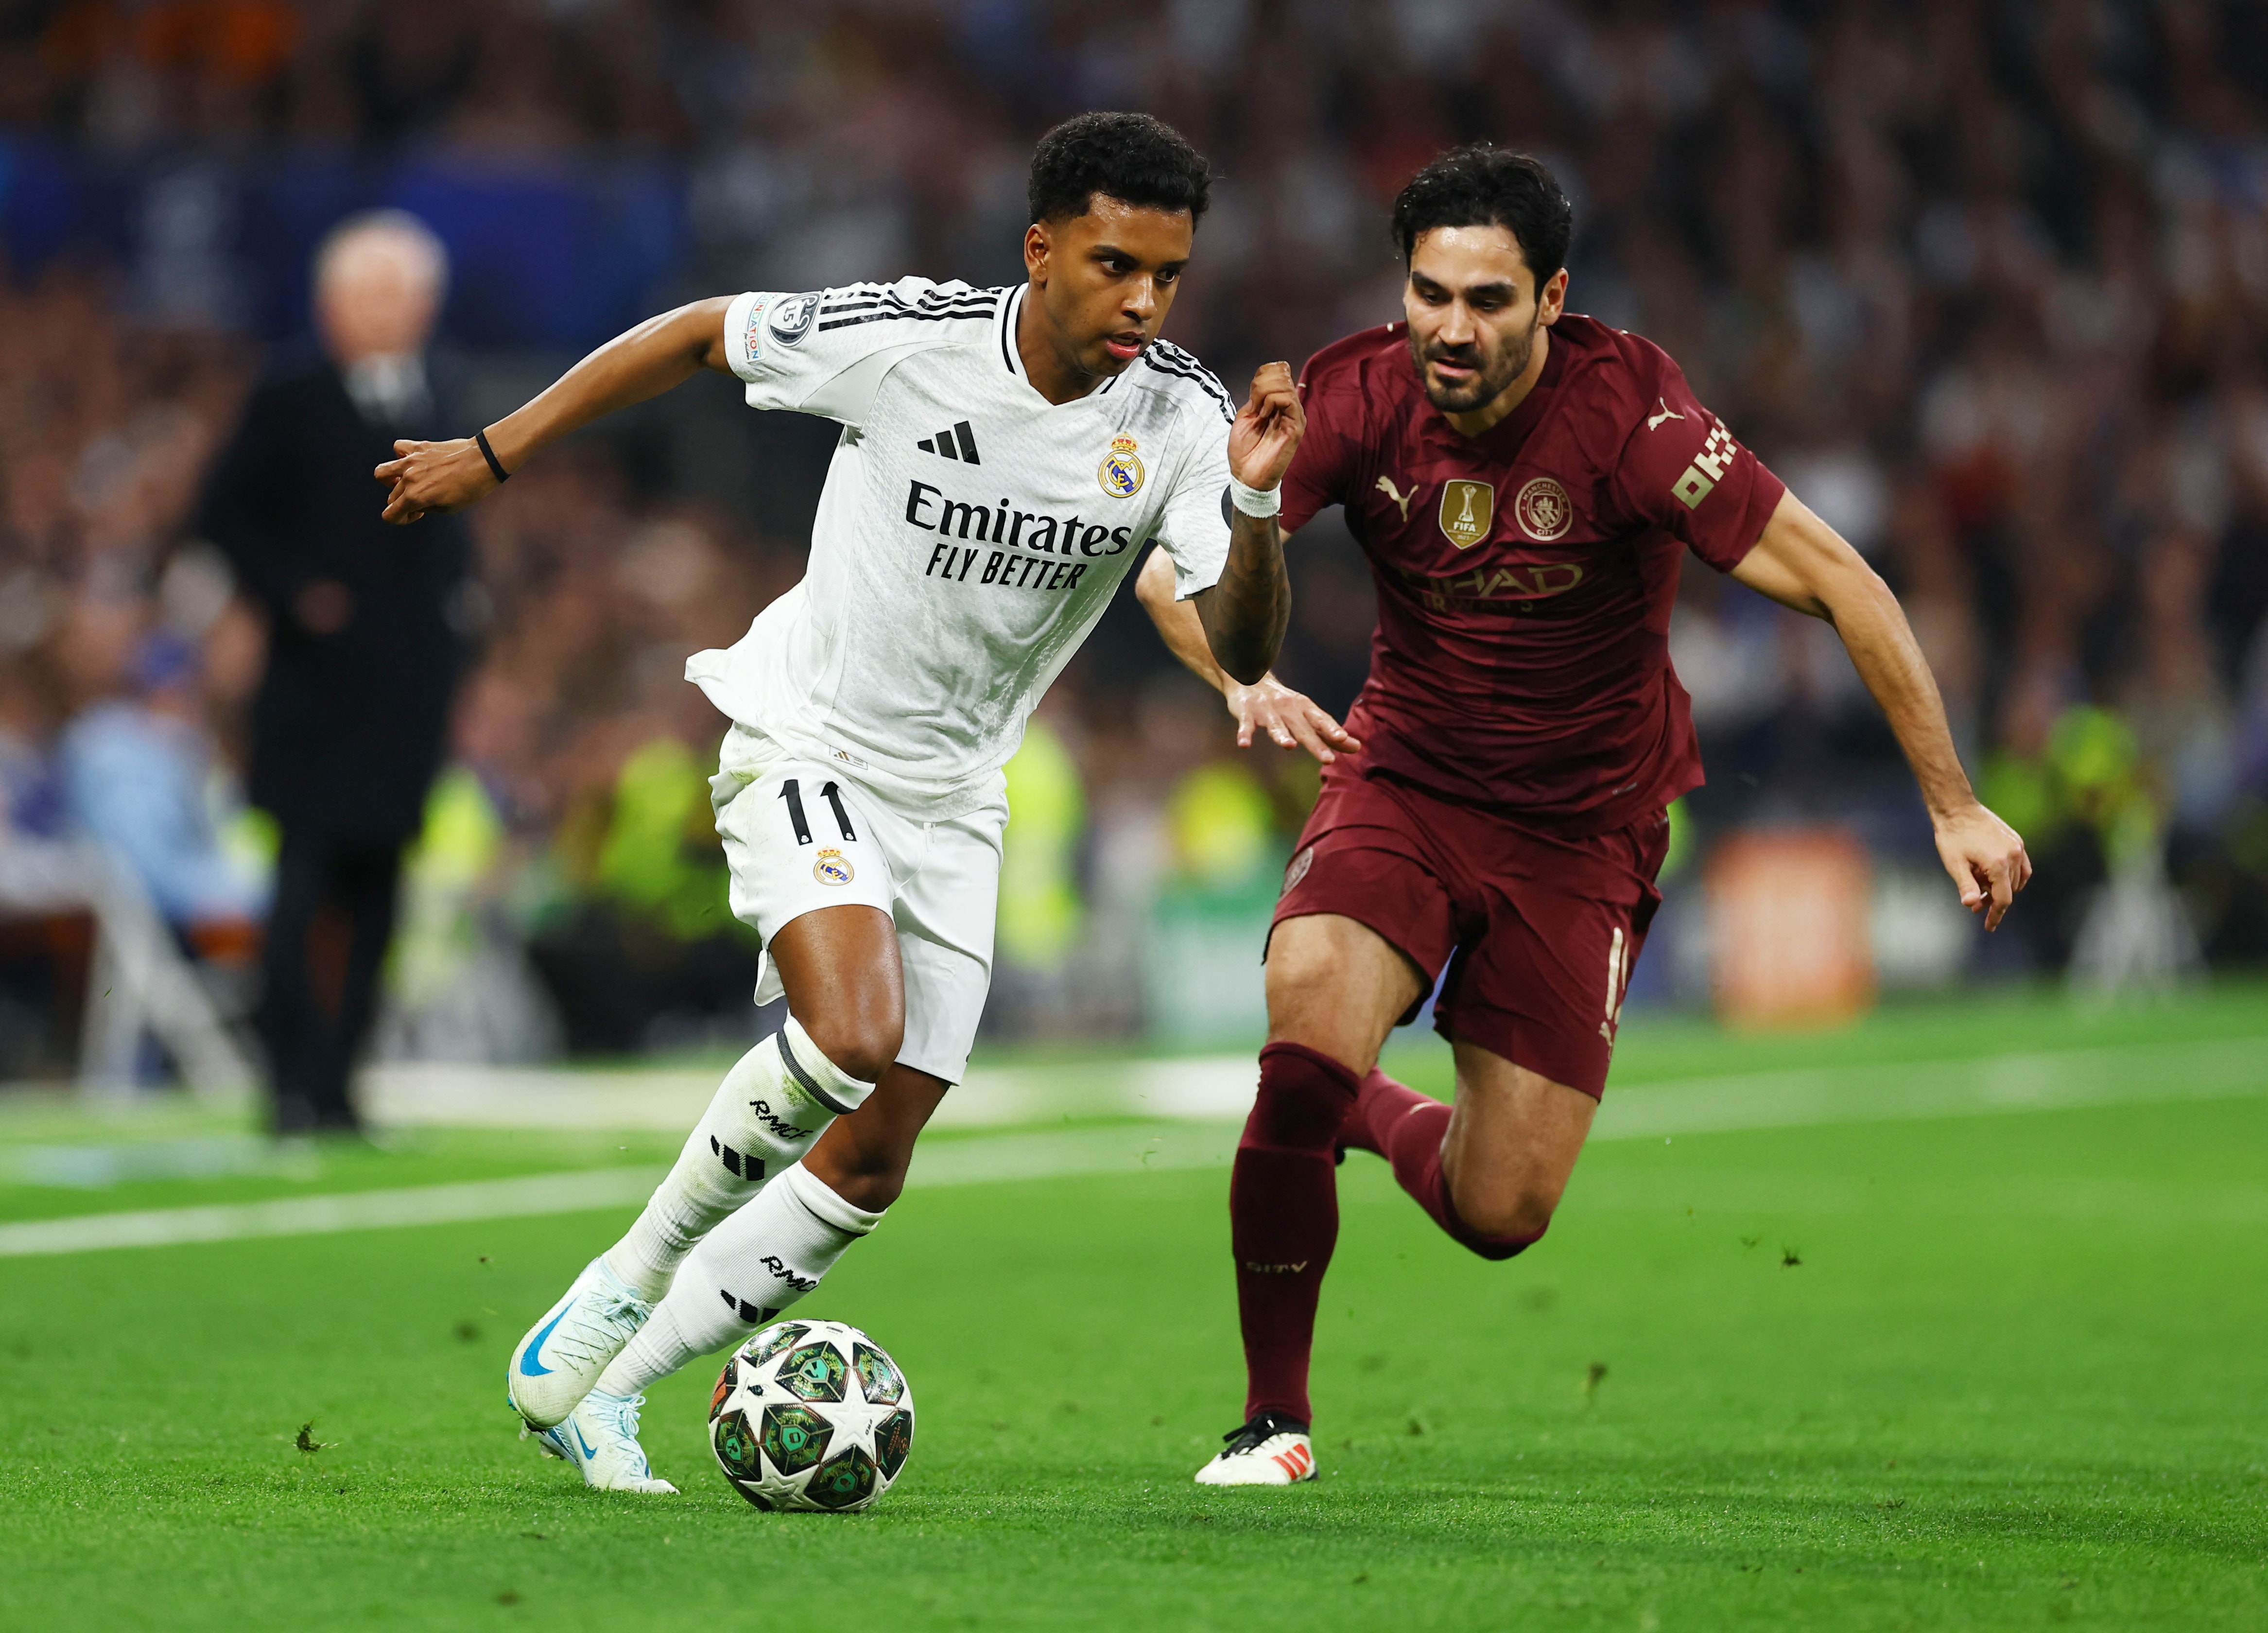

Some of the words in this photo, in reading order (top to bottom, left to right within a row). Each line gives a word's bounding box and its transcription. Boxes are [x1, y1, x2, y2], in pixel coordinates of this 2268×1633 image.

[783, 305, 796, 322] 15
[906, 479, 1132, 557] Emirates
[1454, 521, 1476, 533] FIFA
[926, 543, 979, 582] FLY
[980, 551, 1088, 590] BETTER
[778, 779, 857, 846] 11
[760, 1255, 822, 1292] RMC
